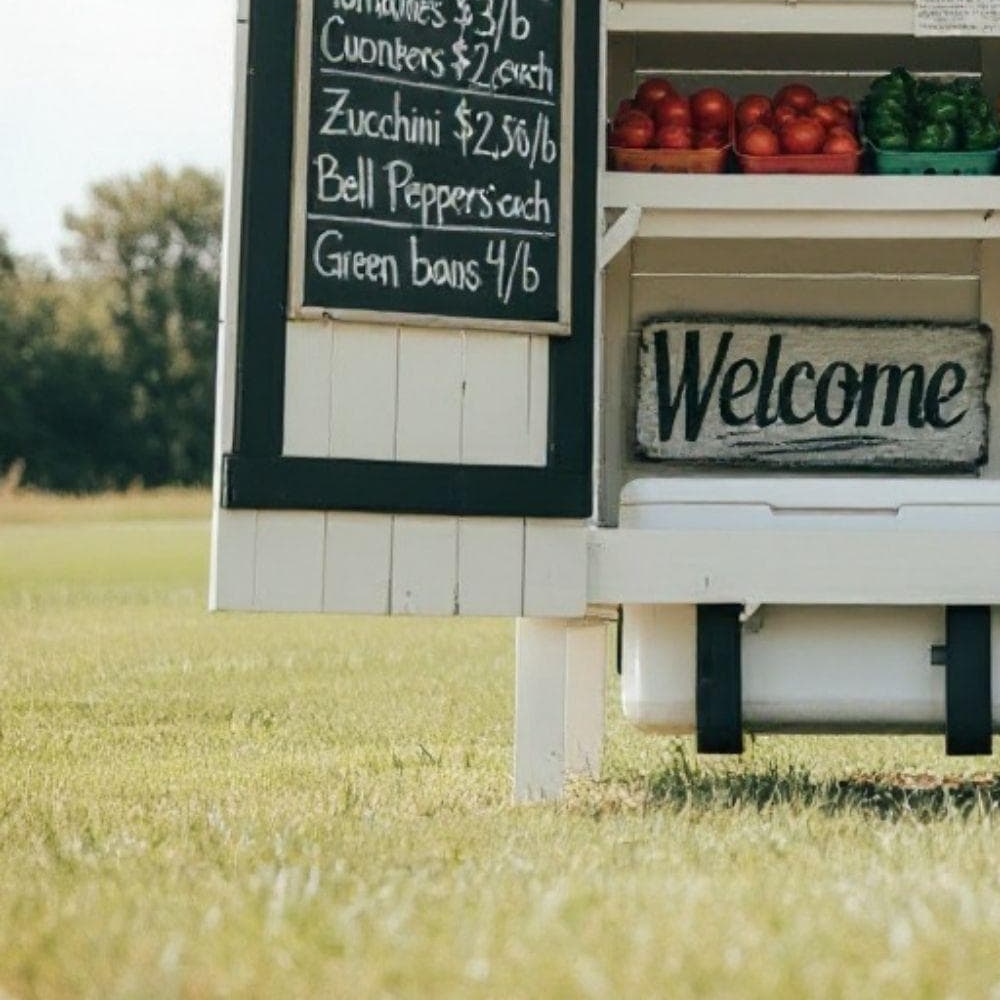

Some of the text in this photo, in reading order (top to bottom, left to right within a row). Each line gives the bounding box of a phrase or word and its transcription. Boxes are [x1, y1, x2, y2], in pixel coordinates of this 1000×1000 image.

[320, 88, 440, 146] Zucchini
[314, 153, 374, 209] Bell
[313, 229, 399, 288] Green
[654, 330, 968, 442] Welcome
